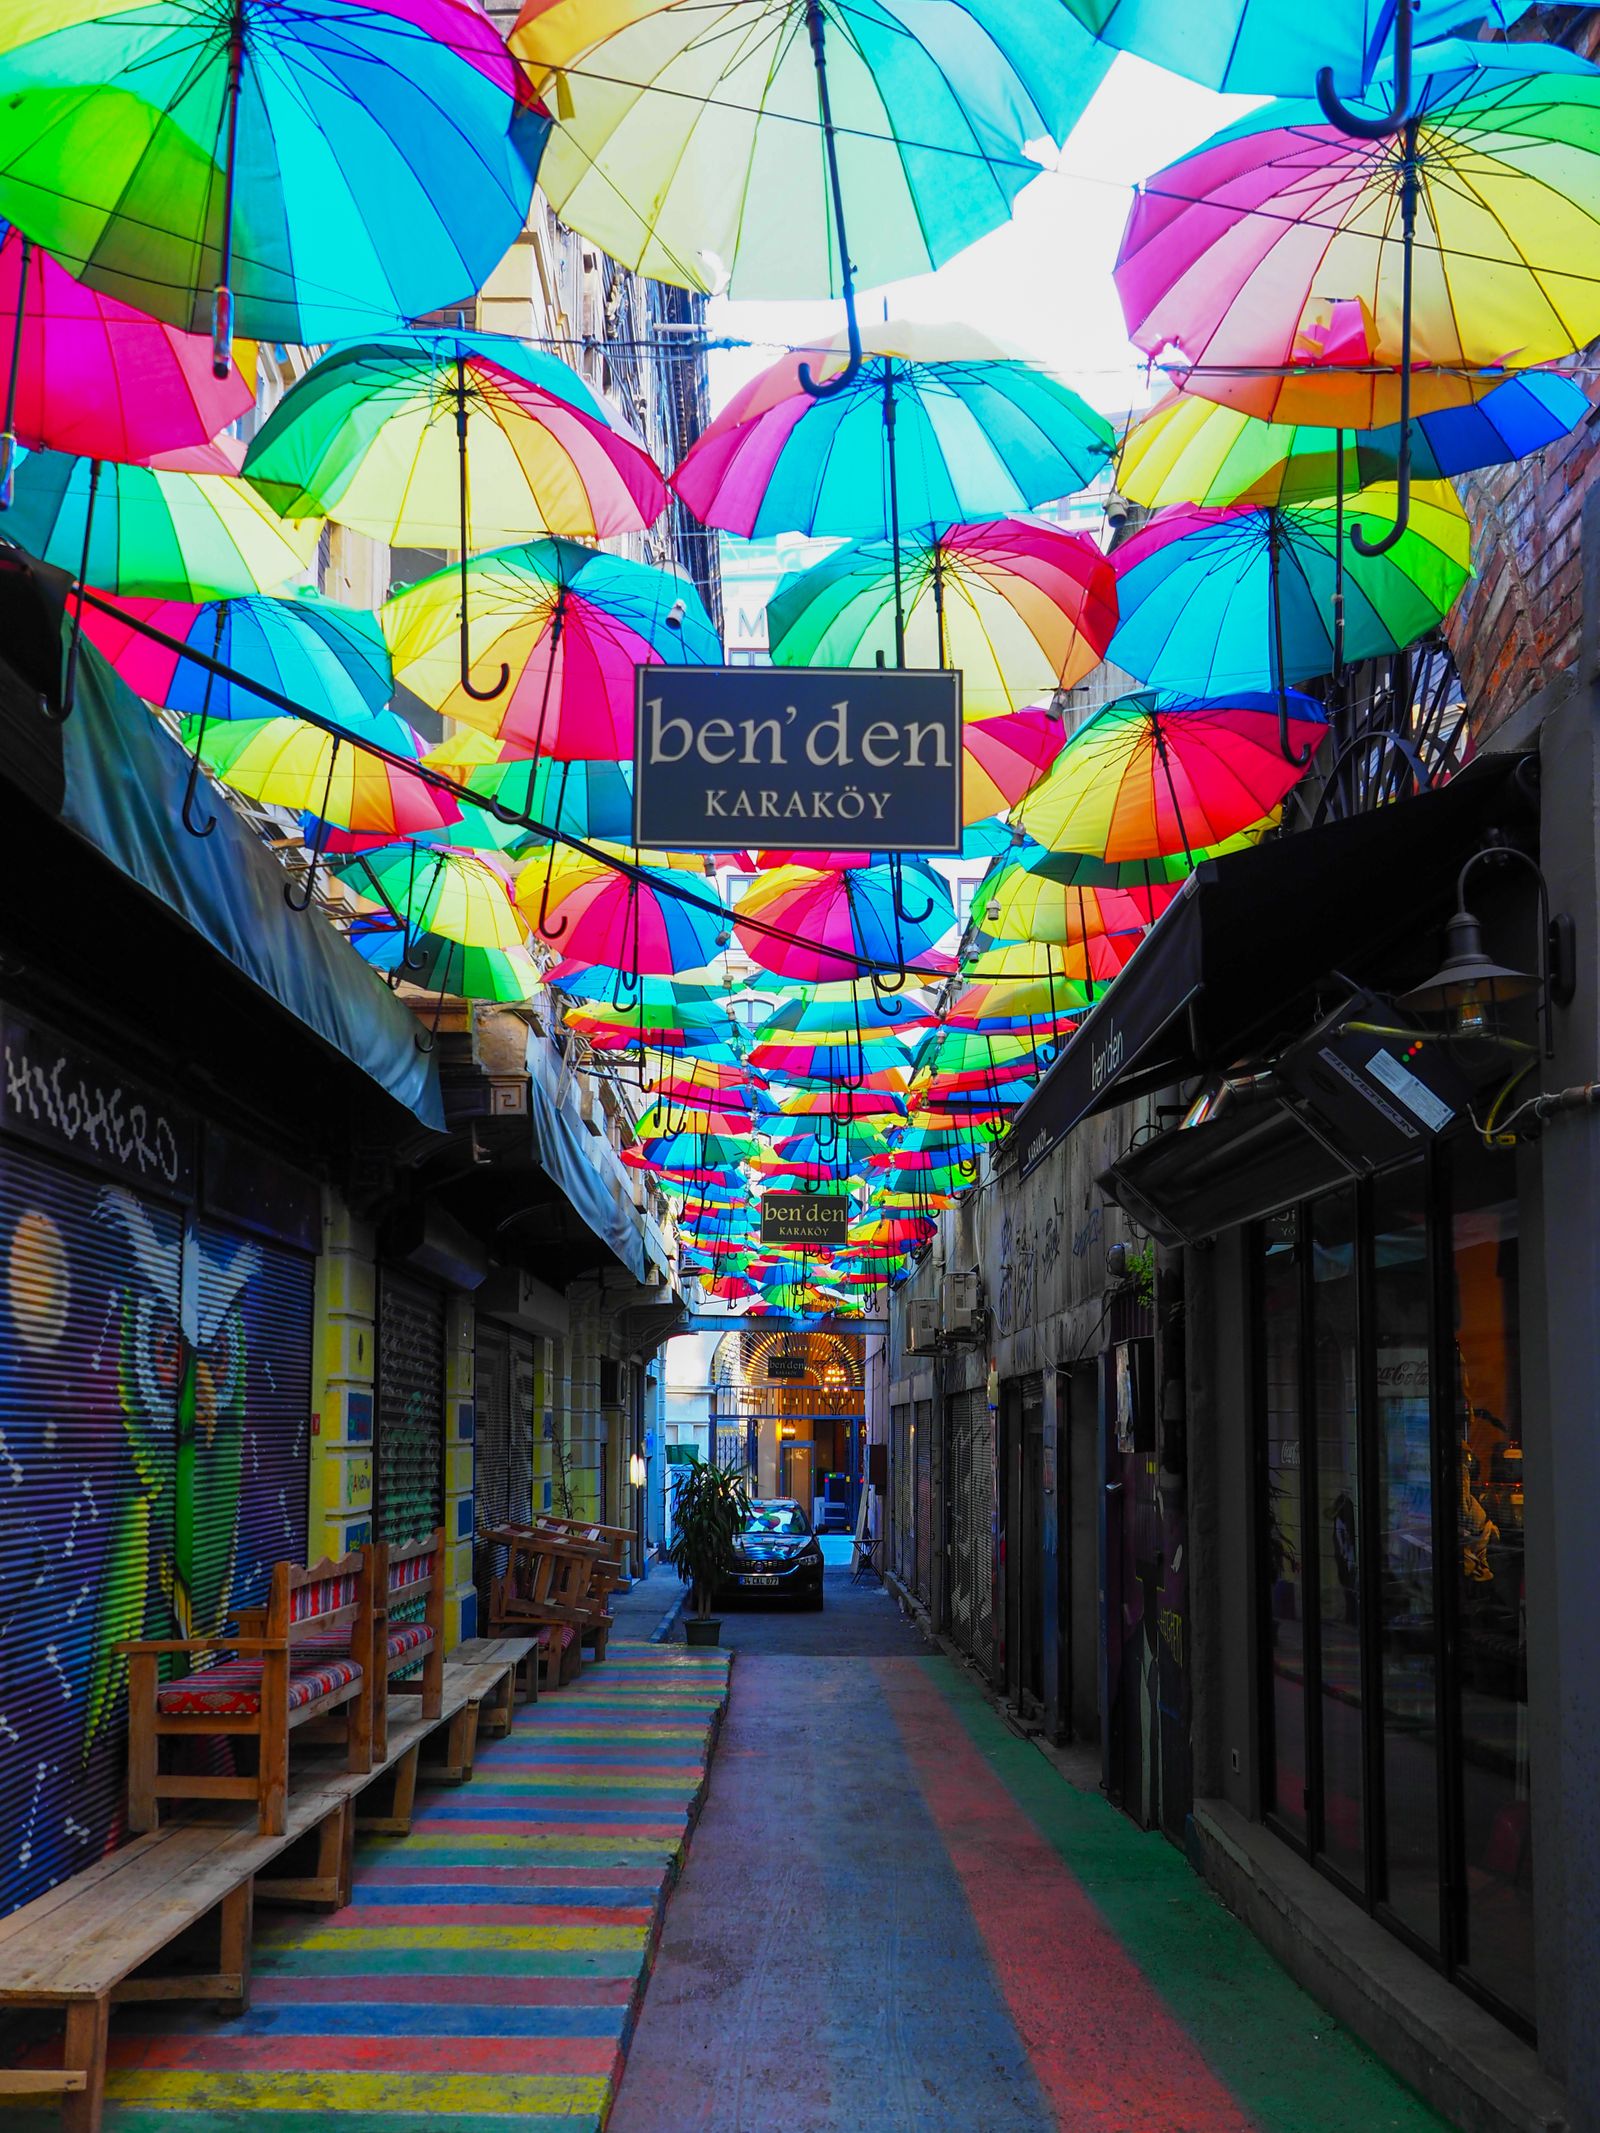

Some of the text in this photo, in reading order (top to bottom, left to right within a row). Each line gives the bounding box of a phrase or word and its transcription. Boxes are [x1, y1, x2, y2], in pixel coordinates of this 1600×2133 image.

[646, 697, 952, 767] ben'den
[705, 786, 892, 819] KARAKÖY
[764, 1202, 845, 1222] ben'den
